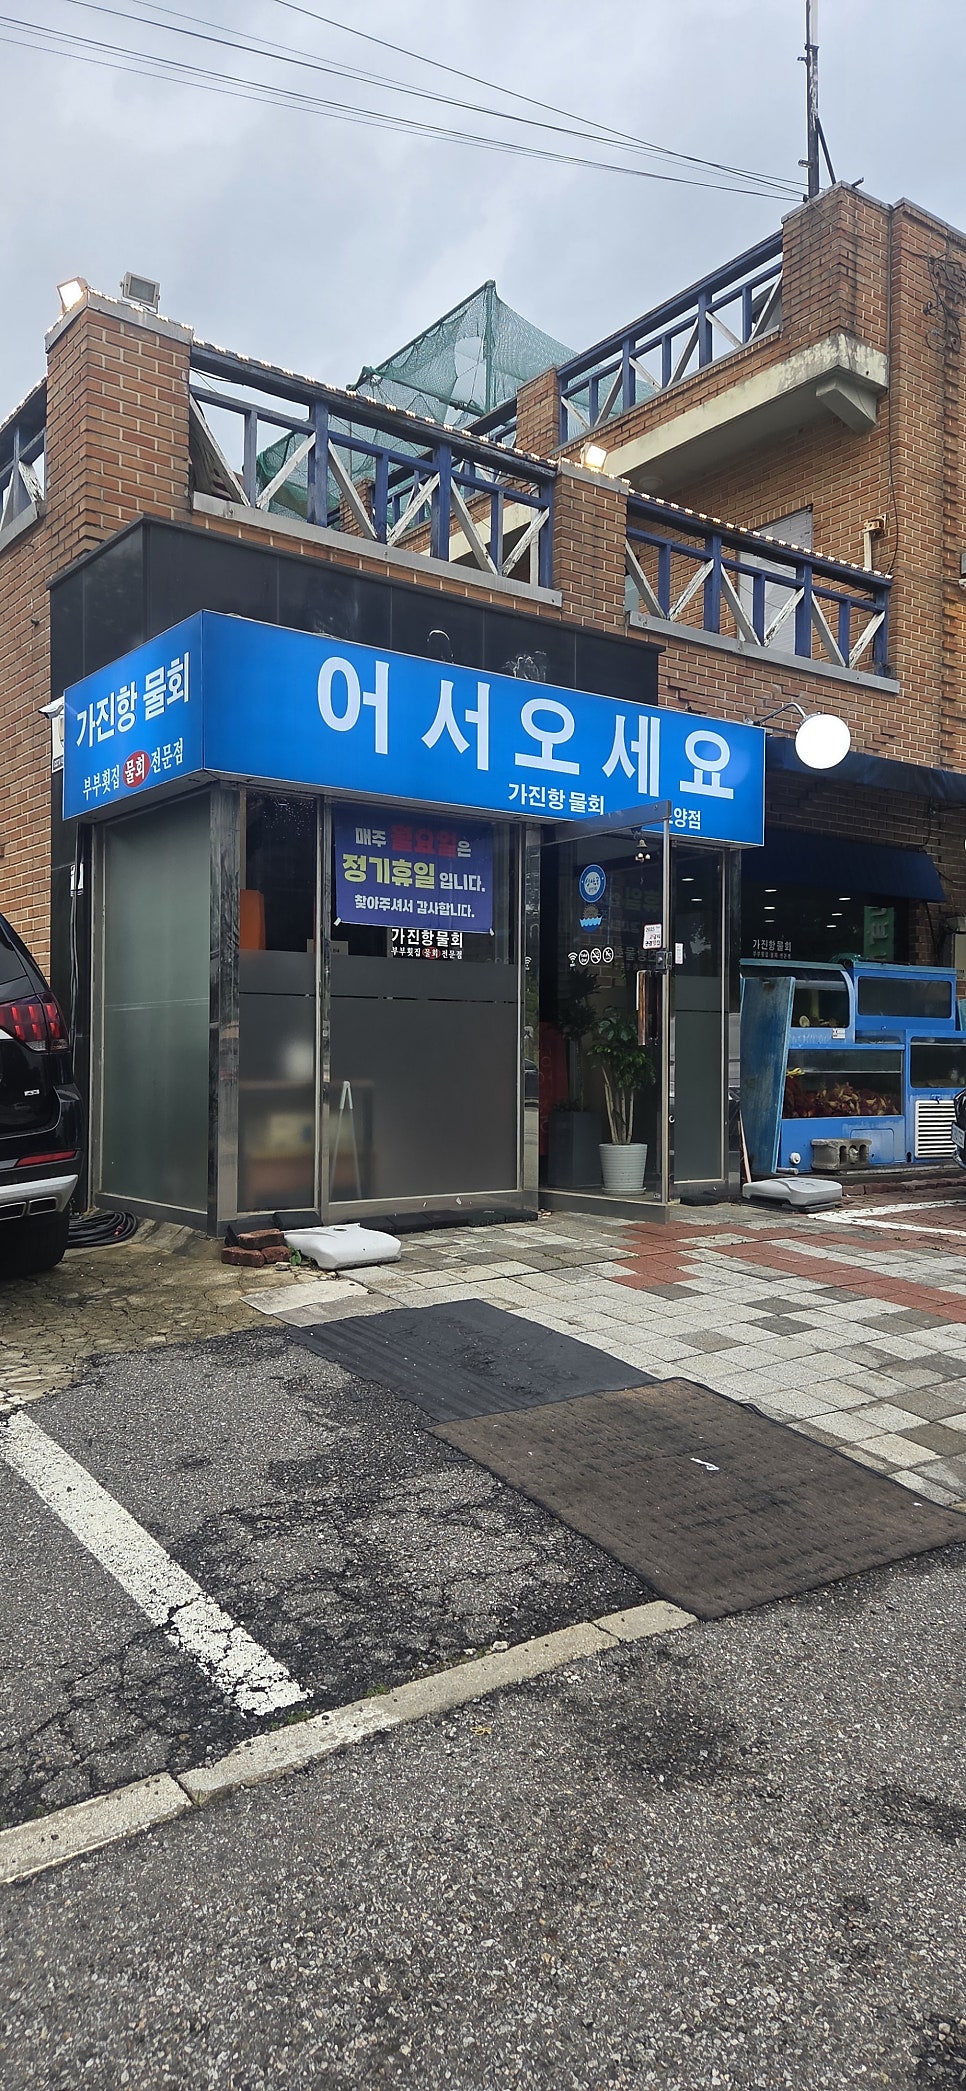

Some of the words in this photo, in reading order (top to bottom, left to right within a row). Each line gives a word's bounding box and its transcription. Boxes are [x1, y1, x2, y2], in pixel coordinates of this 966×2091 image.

[75, 680, 138, 748] 가진항
[143, 651, 190, 721] 물회
[317, 656, 735, 801] 어서오세요
[82, 763, 120, 801] 부부횟집
[124, 753, 145, 785] 물회
[150, 736, 184, 774] 전문점
[508, 782, 566, 810] 가진항
[568, 790, 605, 816] 물회
[669, 806, 702, 830] 양점
[355, 827, 387, 848] 매주
[342, 853, 436, 890] 정기휴일
[439, 872, 486, 893] 입니다.
[354, 894, 414, 913] 찾아주셔서
[416, 900, 475, 918] 감사합니다.
